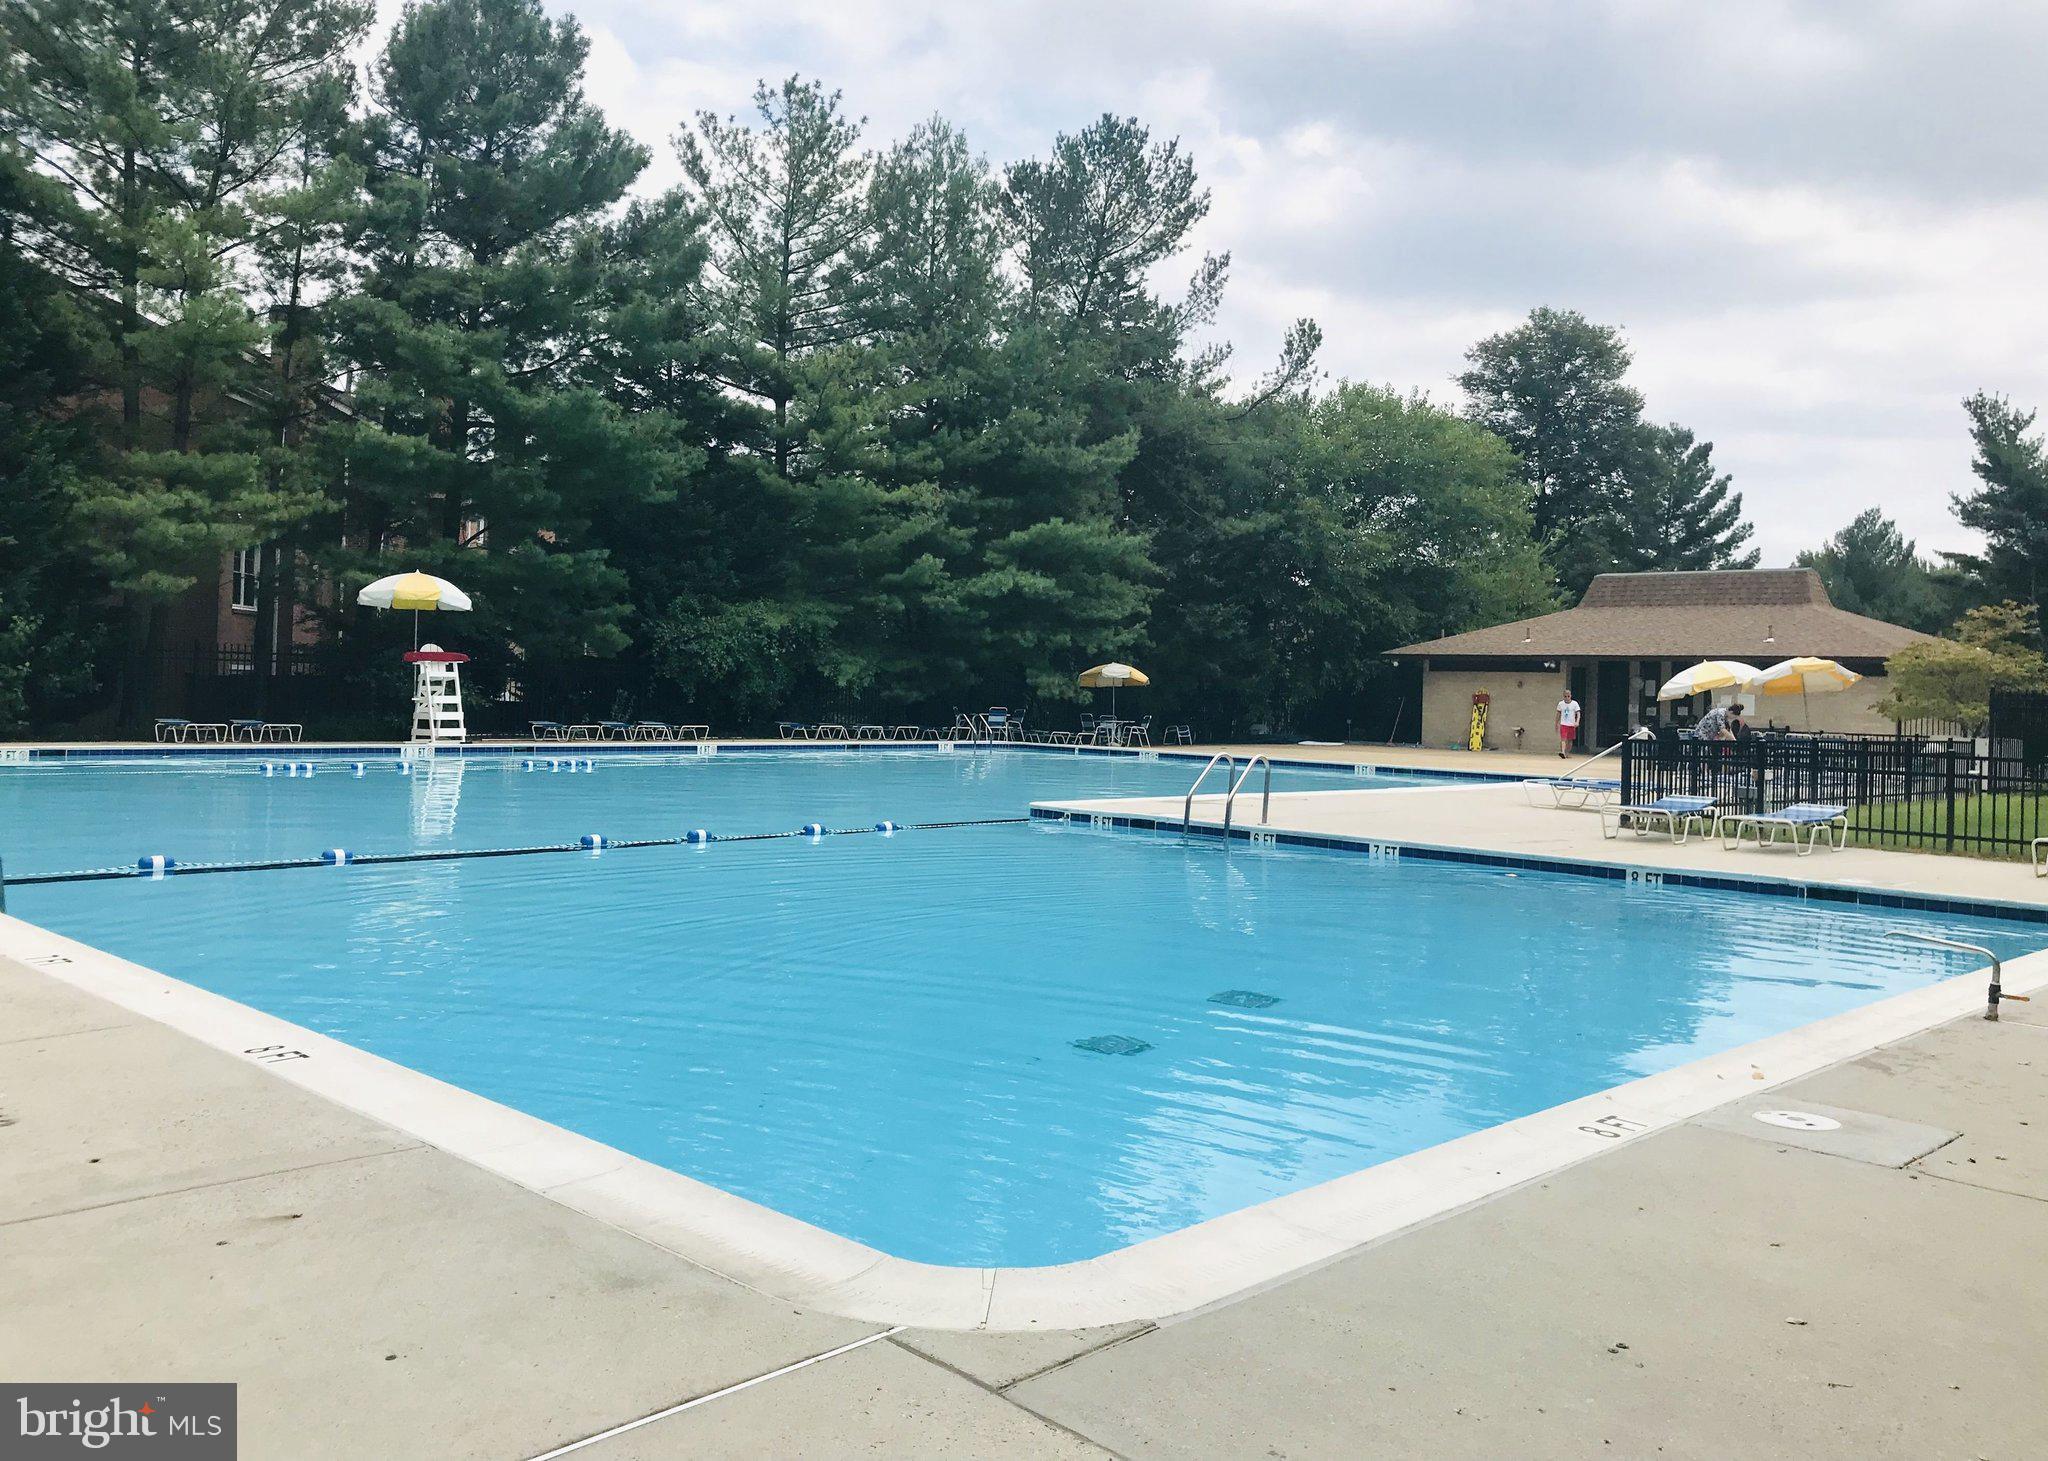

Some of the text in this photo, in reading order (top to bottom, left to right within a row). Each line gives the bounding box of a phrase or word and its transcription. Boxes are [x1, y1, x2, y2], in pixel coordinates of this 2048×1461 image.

[1253, 832, 1275, 847] 6 FT
[1373, 844, 1398, 859] 7 FT
[1631, 870, 1661, 887] 8 FT
[243, 1045, 310, 1064] 8 FT
[1577, 1114, 1649, 1139] 8 FT
